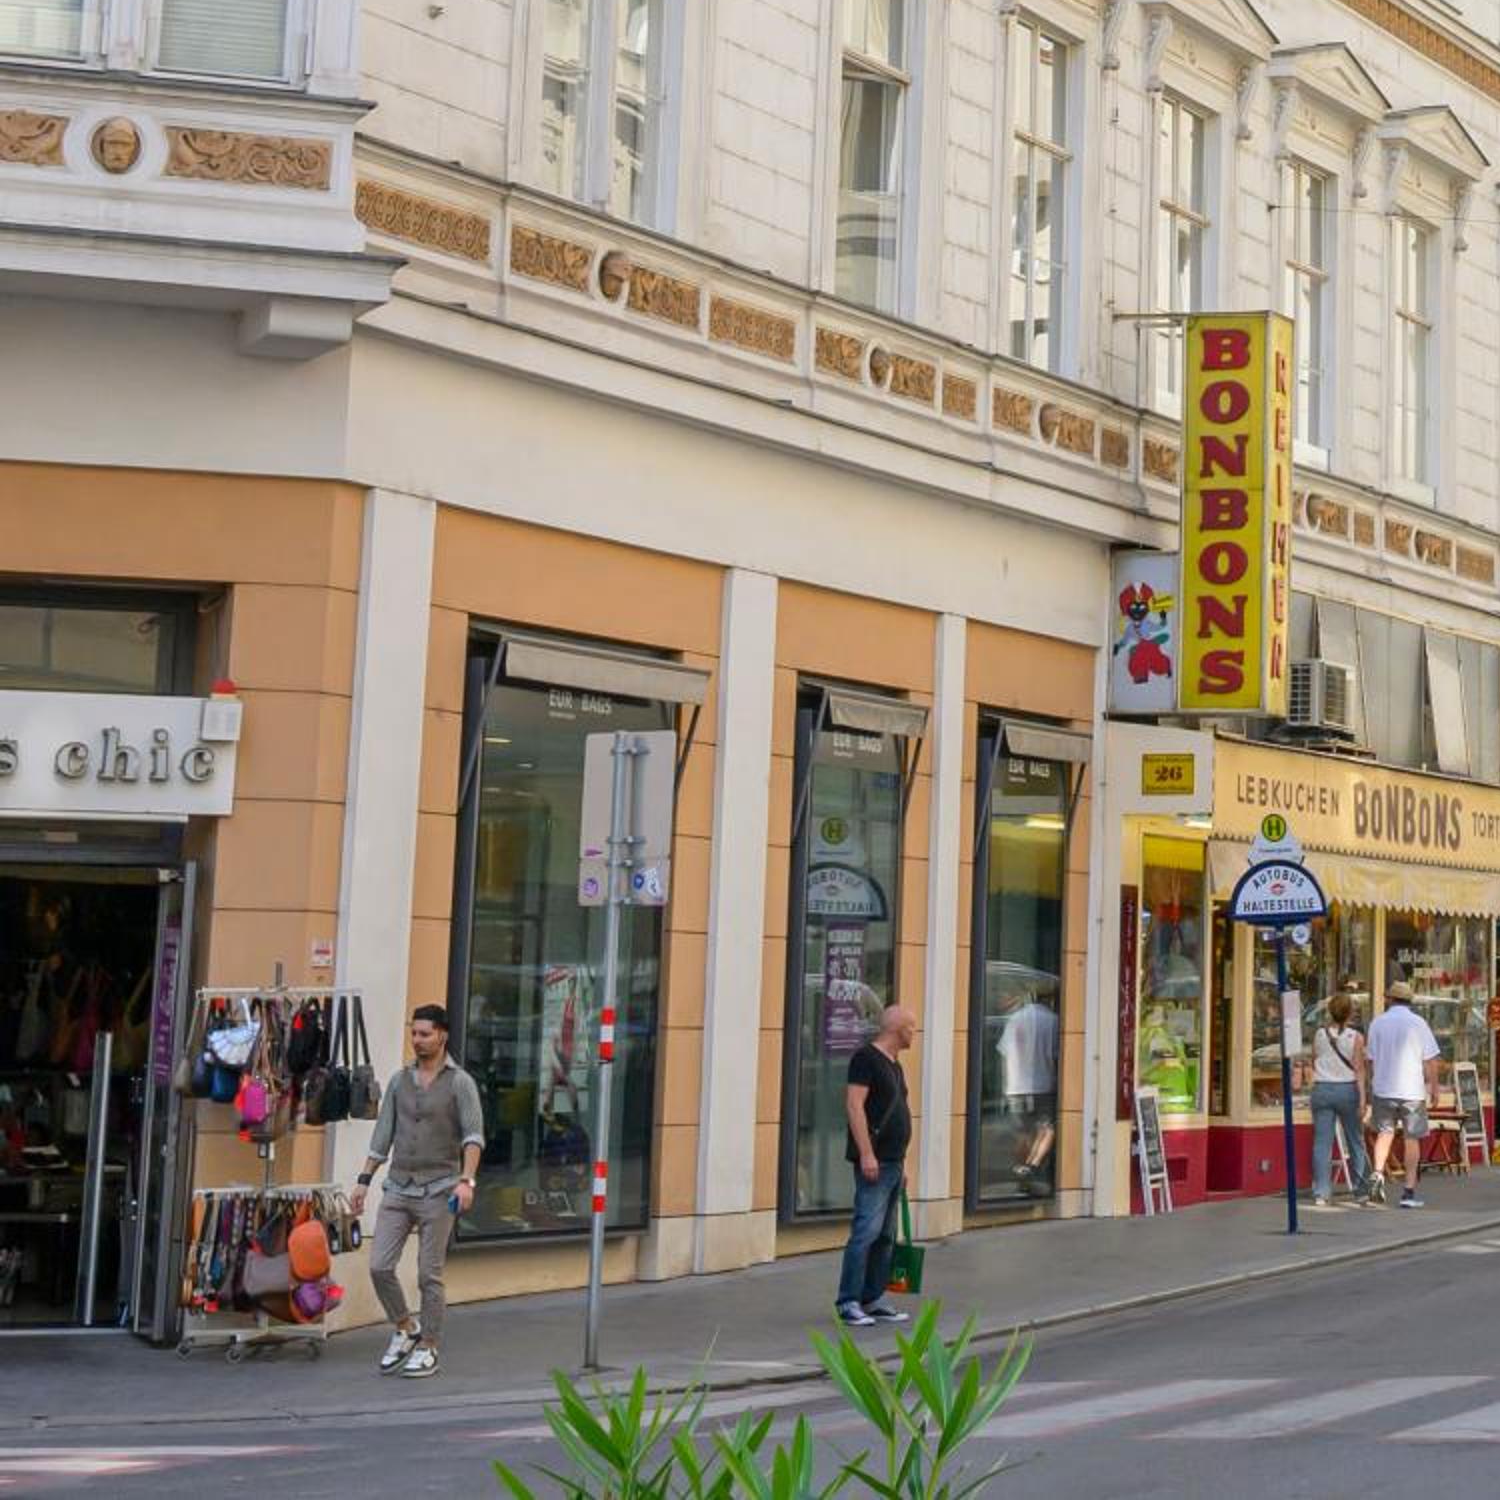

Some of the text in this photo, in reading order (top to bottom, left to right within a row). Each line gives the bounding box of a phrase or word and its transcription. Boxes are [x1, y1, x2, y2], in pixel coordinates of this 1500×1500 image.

[1197, 328, 1251, 695] BONBONS
[1271, 351, 1288, 680] REIMER
[55, 727, 215, 782] chic
[1155, 765, 1183, 782] 26
[1237, 771, 1339, 817] LEBKUCHEN
[1252, 869, 1305, 890] AUTOBUS
[1243, 897, 1314, 912] HALTESTELLE
